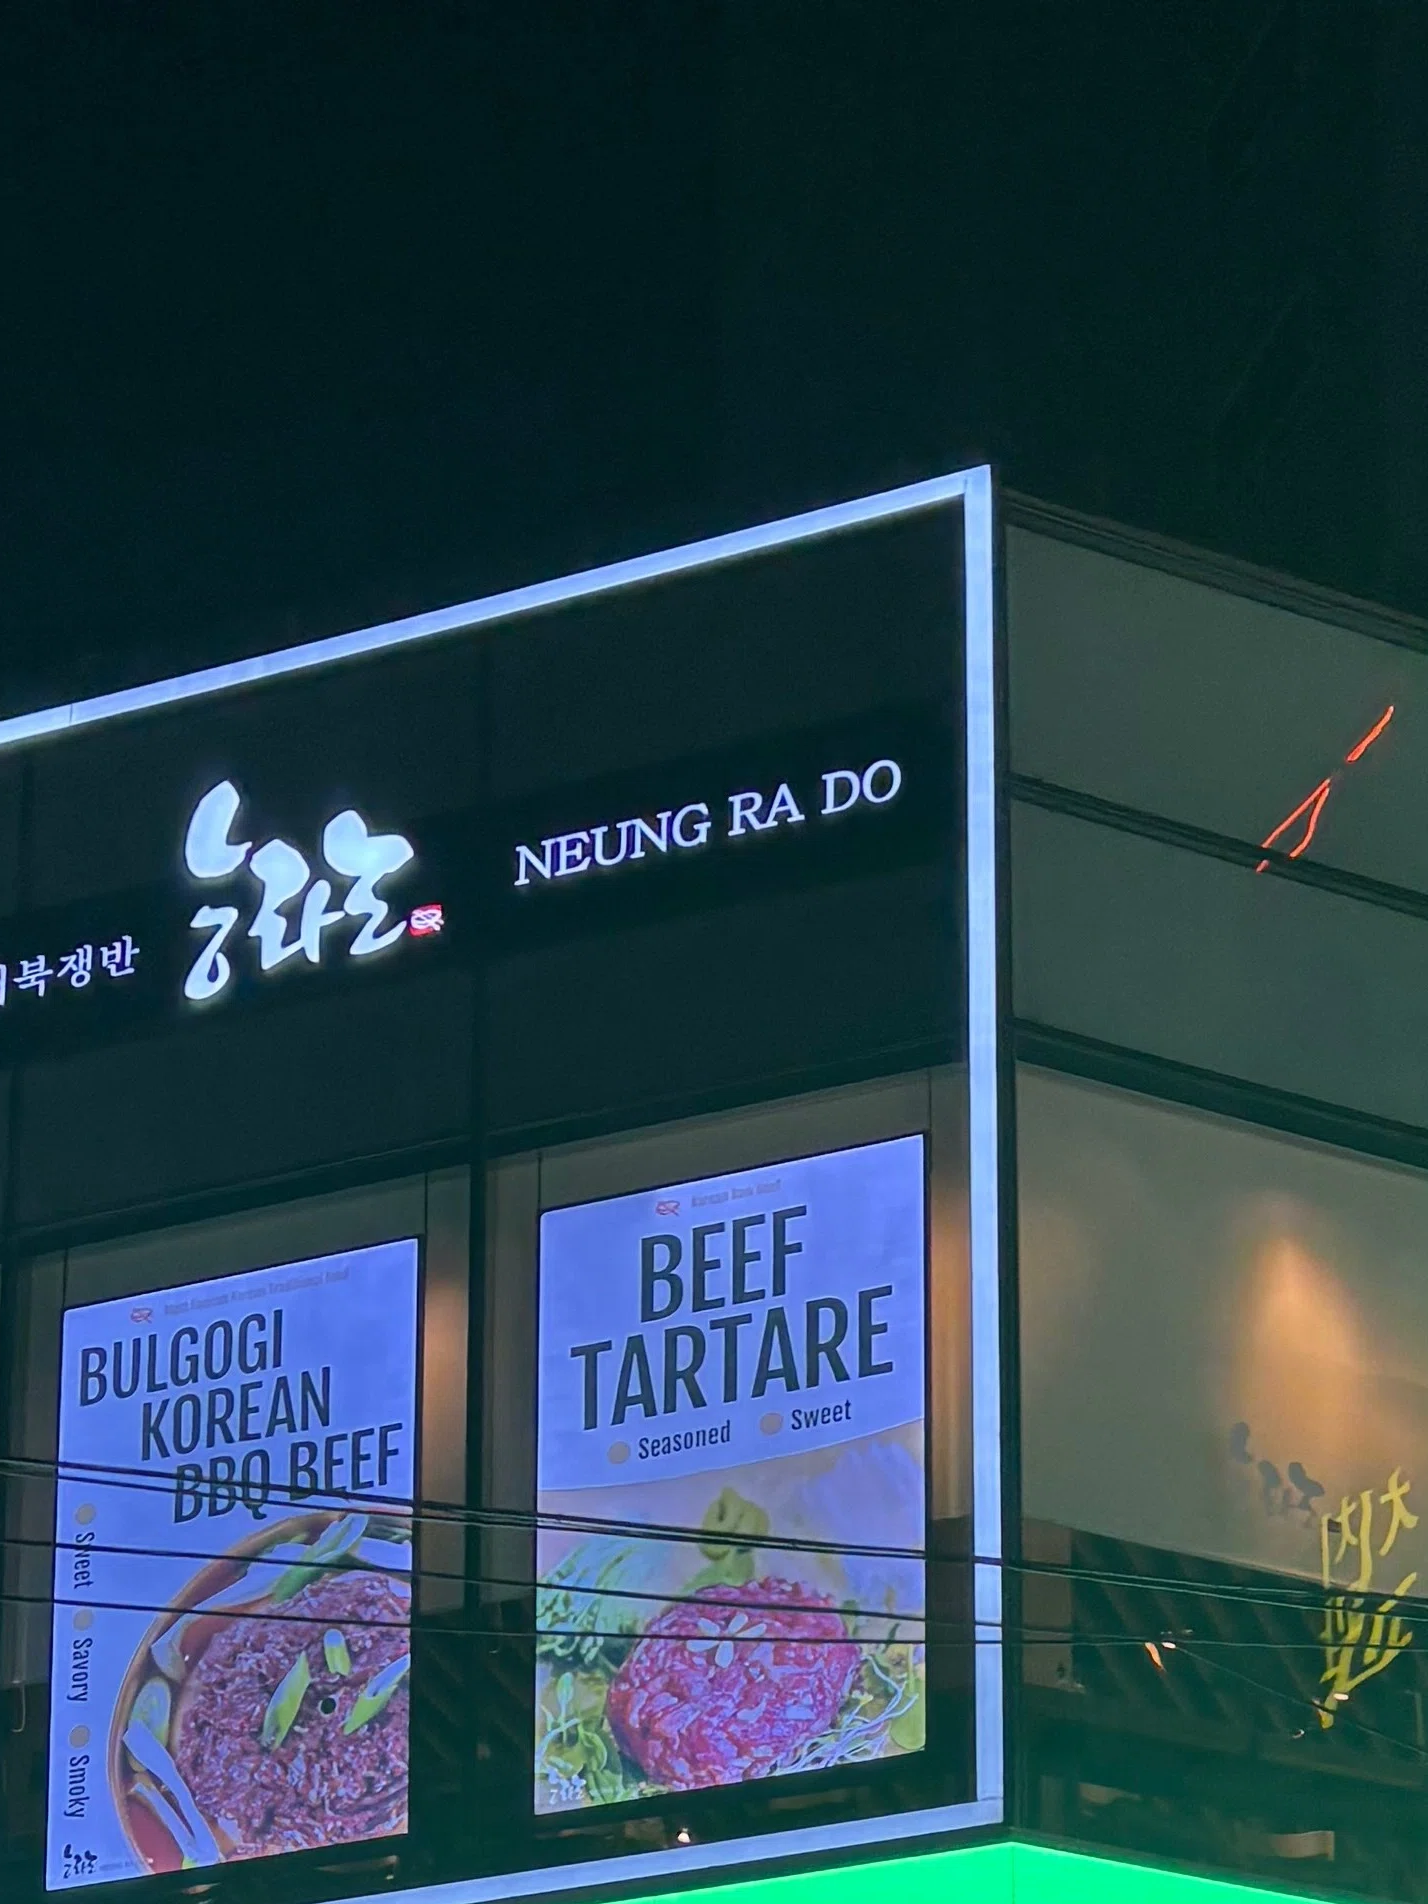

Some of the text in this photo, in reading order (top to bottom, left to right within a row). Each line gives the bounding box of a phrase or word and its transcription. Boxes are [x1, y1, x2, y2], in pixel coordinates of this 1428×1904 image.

[514, 759, 902, 886] NEUNG RA DO
[640, 1204, 808, 1325] BEEF
[79, 1308, 284, 1408] BULGOGI
[570, 1284, 894, 1432] TARTARE
[141, 1366, 331, 1462] KOREAN
[638, 1400, 853, 1461] Seasoned Sweet
[174, 1422, 404, 1524] BBQ BEEF
[73, 1531, 95, 1590] Sweet
[68, 1636, 93, 1703] Savory
[63, 1755, 90, 1819] Smoky
